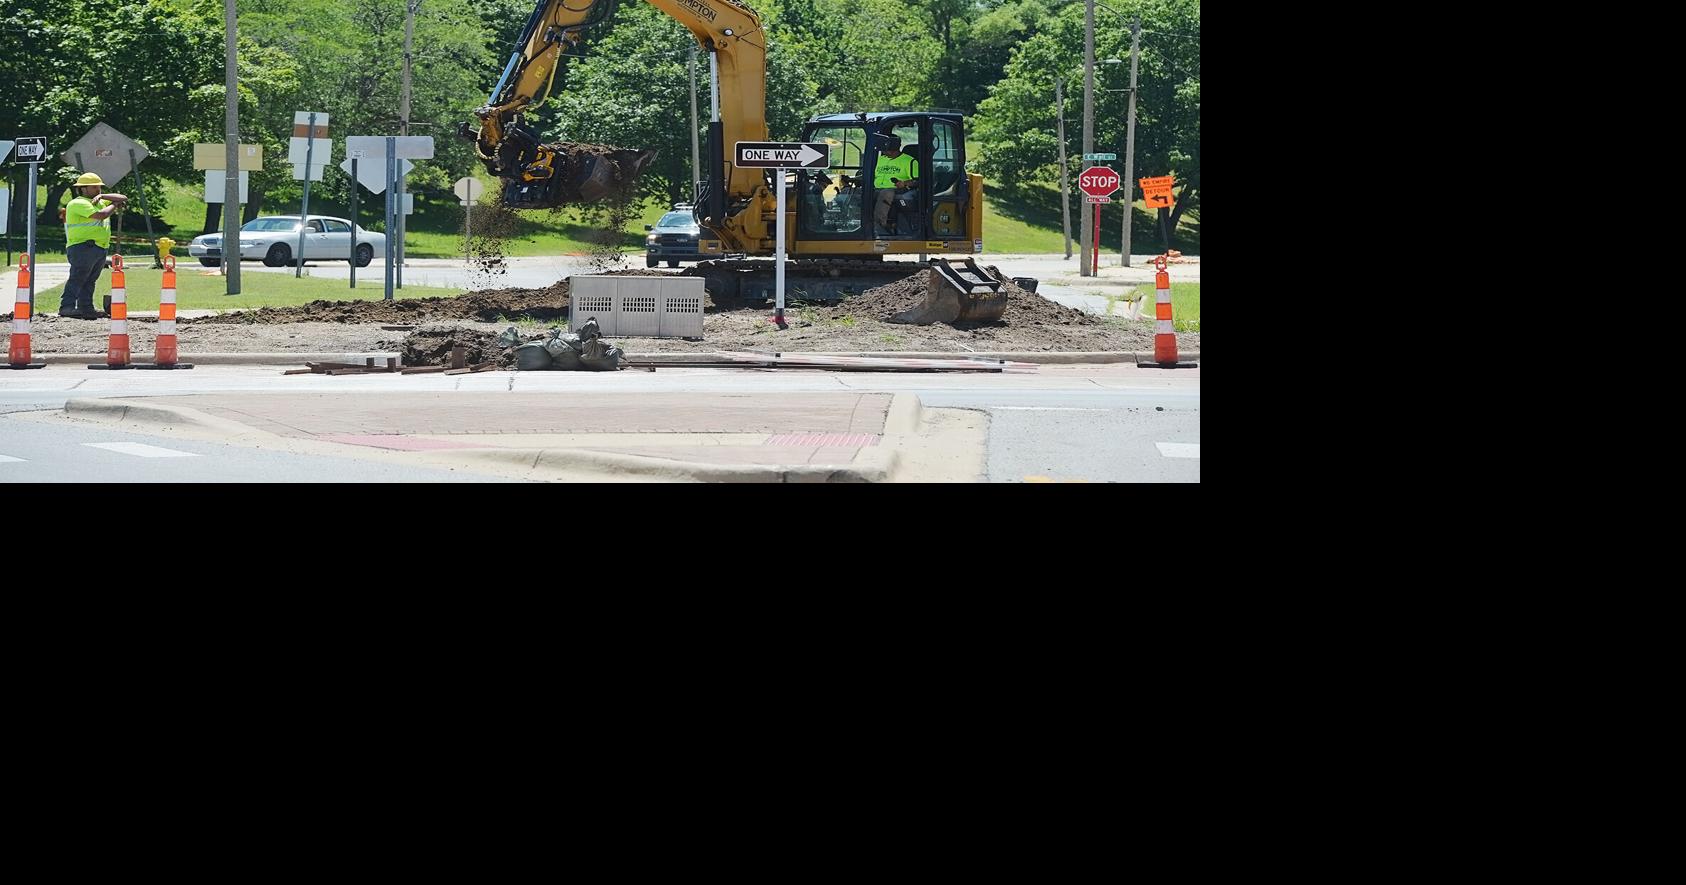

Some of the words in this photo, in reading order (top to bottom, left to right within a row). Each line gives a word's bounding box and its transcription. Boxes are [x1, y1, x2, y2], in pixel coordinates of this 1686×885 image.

[677, 0, 717, 21] MPTON
[19, 145, 28, 155] ONE
[28, 144, 38, 154] WAY
[745, 150, 770, 160] ONE
[774, 150, 801, 160] WAY
[1082, 175, 1117, 188] STOP
